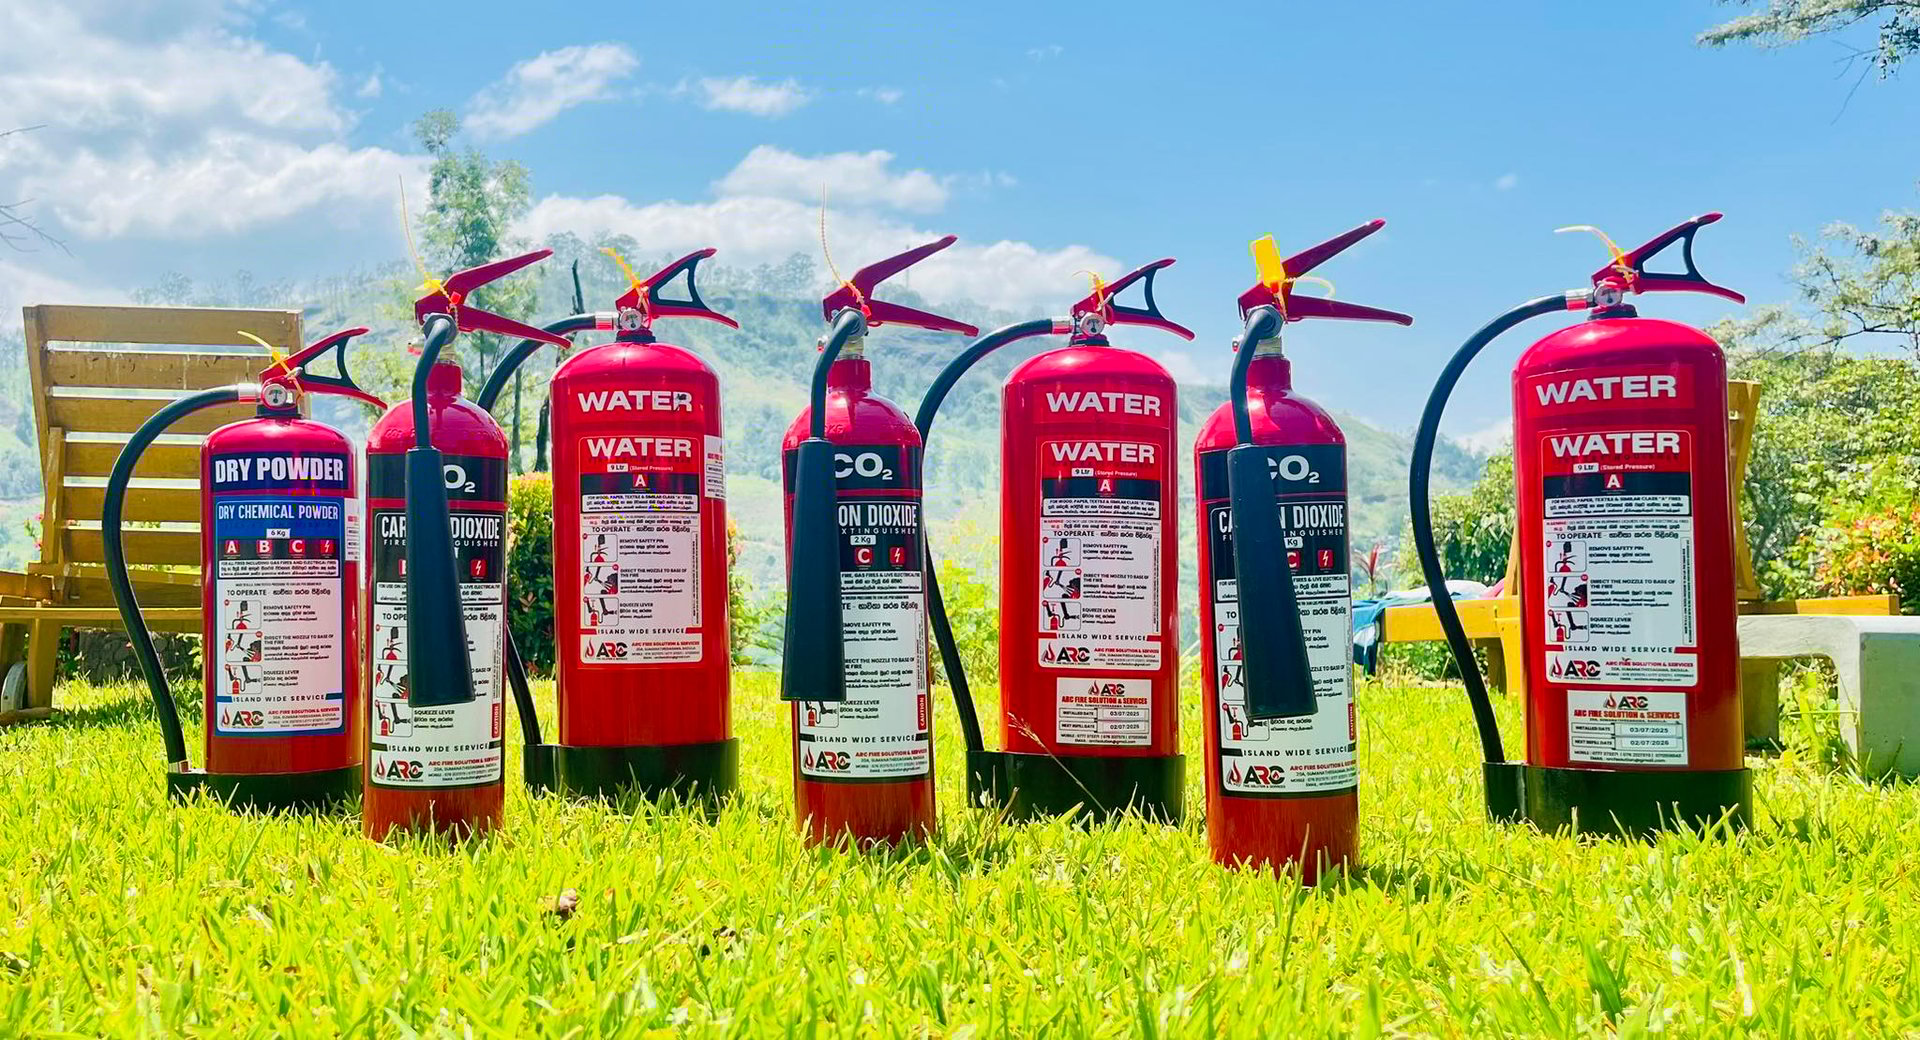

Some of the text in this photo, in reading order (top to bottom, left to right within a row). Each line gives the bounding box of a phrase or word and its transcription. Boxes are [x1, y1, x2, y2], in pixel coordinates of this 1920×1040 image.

[1536, 375, 1677, 406] WATER
[577, 390, 693, 413] WATER
[1046, 391, 1160, 417] WATER
[587, 438, 692, 458] WATER
[1051, 442, 1155, 464] WATER
[1551, 432, 1680, 458] WATER
[215, 457, 344, 483] DRY POWDER
[1624, 463, 1655, 471] Pressure)
[635, 474, 647, 487] A
[1100, 479, 1111, 492] A
[1606, 474, 1621, 488] A
[219, 504, 339, 520] DRY CHEMICAL POWDER
[868, 504, 918, 527] DIOXIDE
[1293, 505, 1345, 529] DIOXIDE
[277, 530, 286, 538] Kg
[382, 516, 407, 538] CAR
[450, 516, 500, 539] DIOXIDE
[841, 527, 916, 535] XTINGUISHER
[227, 540, 303, 553] A B C
[861, 536, 871, 544] Kg
[1287, 538, 1298, 547] Kg
[857, 548, 871, 564] C
[382, 613, 392, 621] TO
[1226, 611, 1237, 619] TO
[596, 642, 628, 658] ARC
[1056, 646, 1090, 663] ARC
[1564, 660, 1601, 677] ARC
[1101, 683, 1125, 695] ARC
[1123, 697, 1148, 705] SERVICES
[1618, 696, 1649, 708] ARC
[232, 710, 264, 726] ARC
[1574, 709, 1587, 717] ARC
[1588, 710, 1602, 718] FIRE
[1603, 710, 1638, 719] SOLUTION
[1646, 711, 1680, 720] SERVICES
[816, 735, 848, 743] ISLAND
[389, 745, 421, 753] ISLAND
[1243, 749, 1281, 757] ISLAND
[815, 750, 851, 770] ARC
[386, 760, 424, 779] ARC
[1243, 765, 1286, 785] ARC
